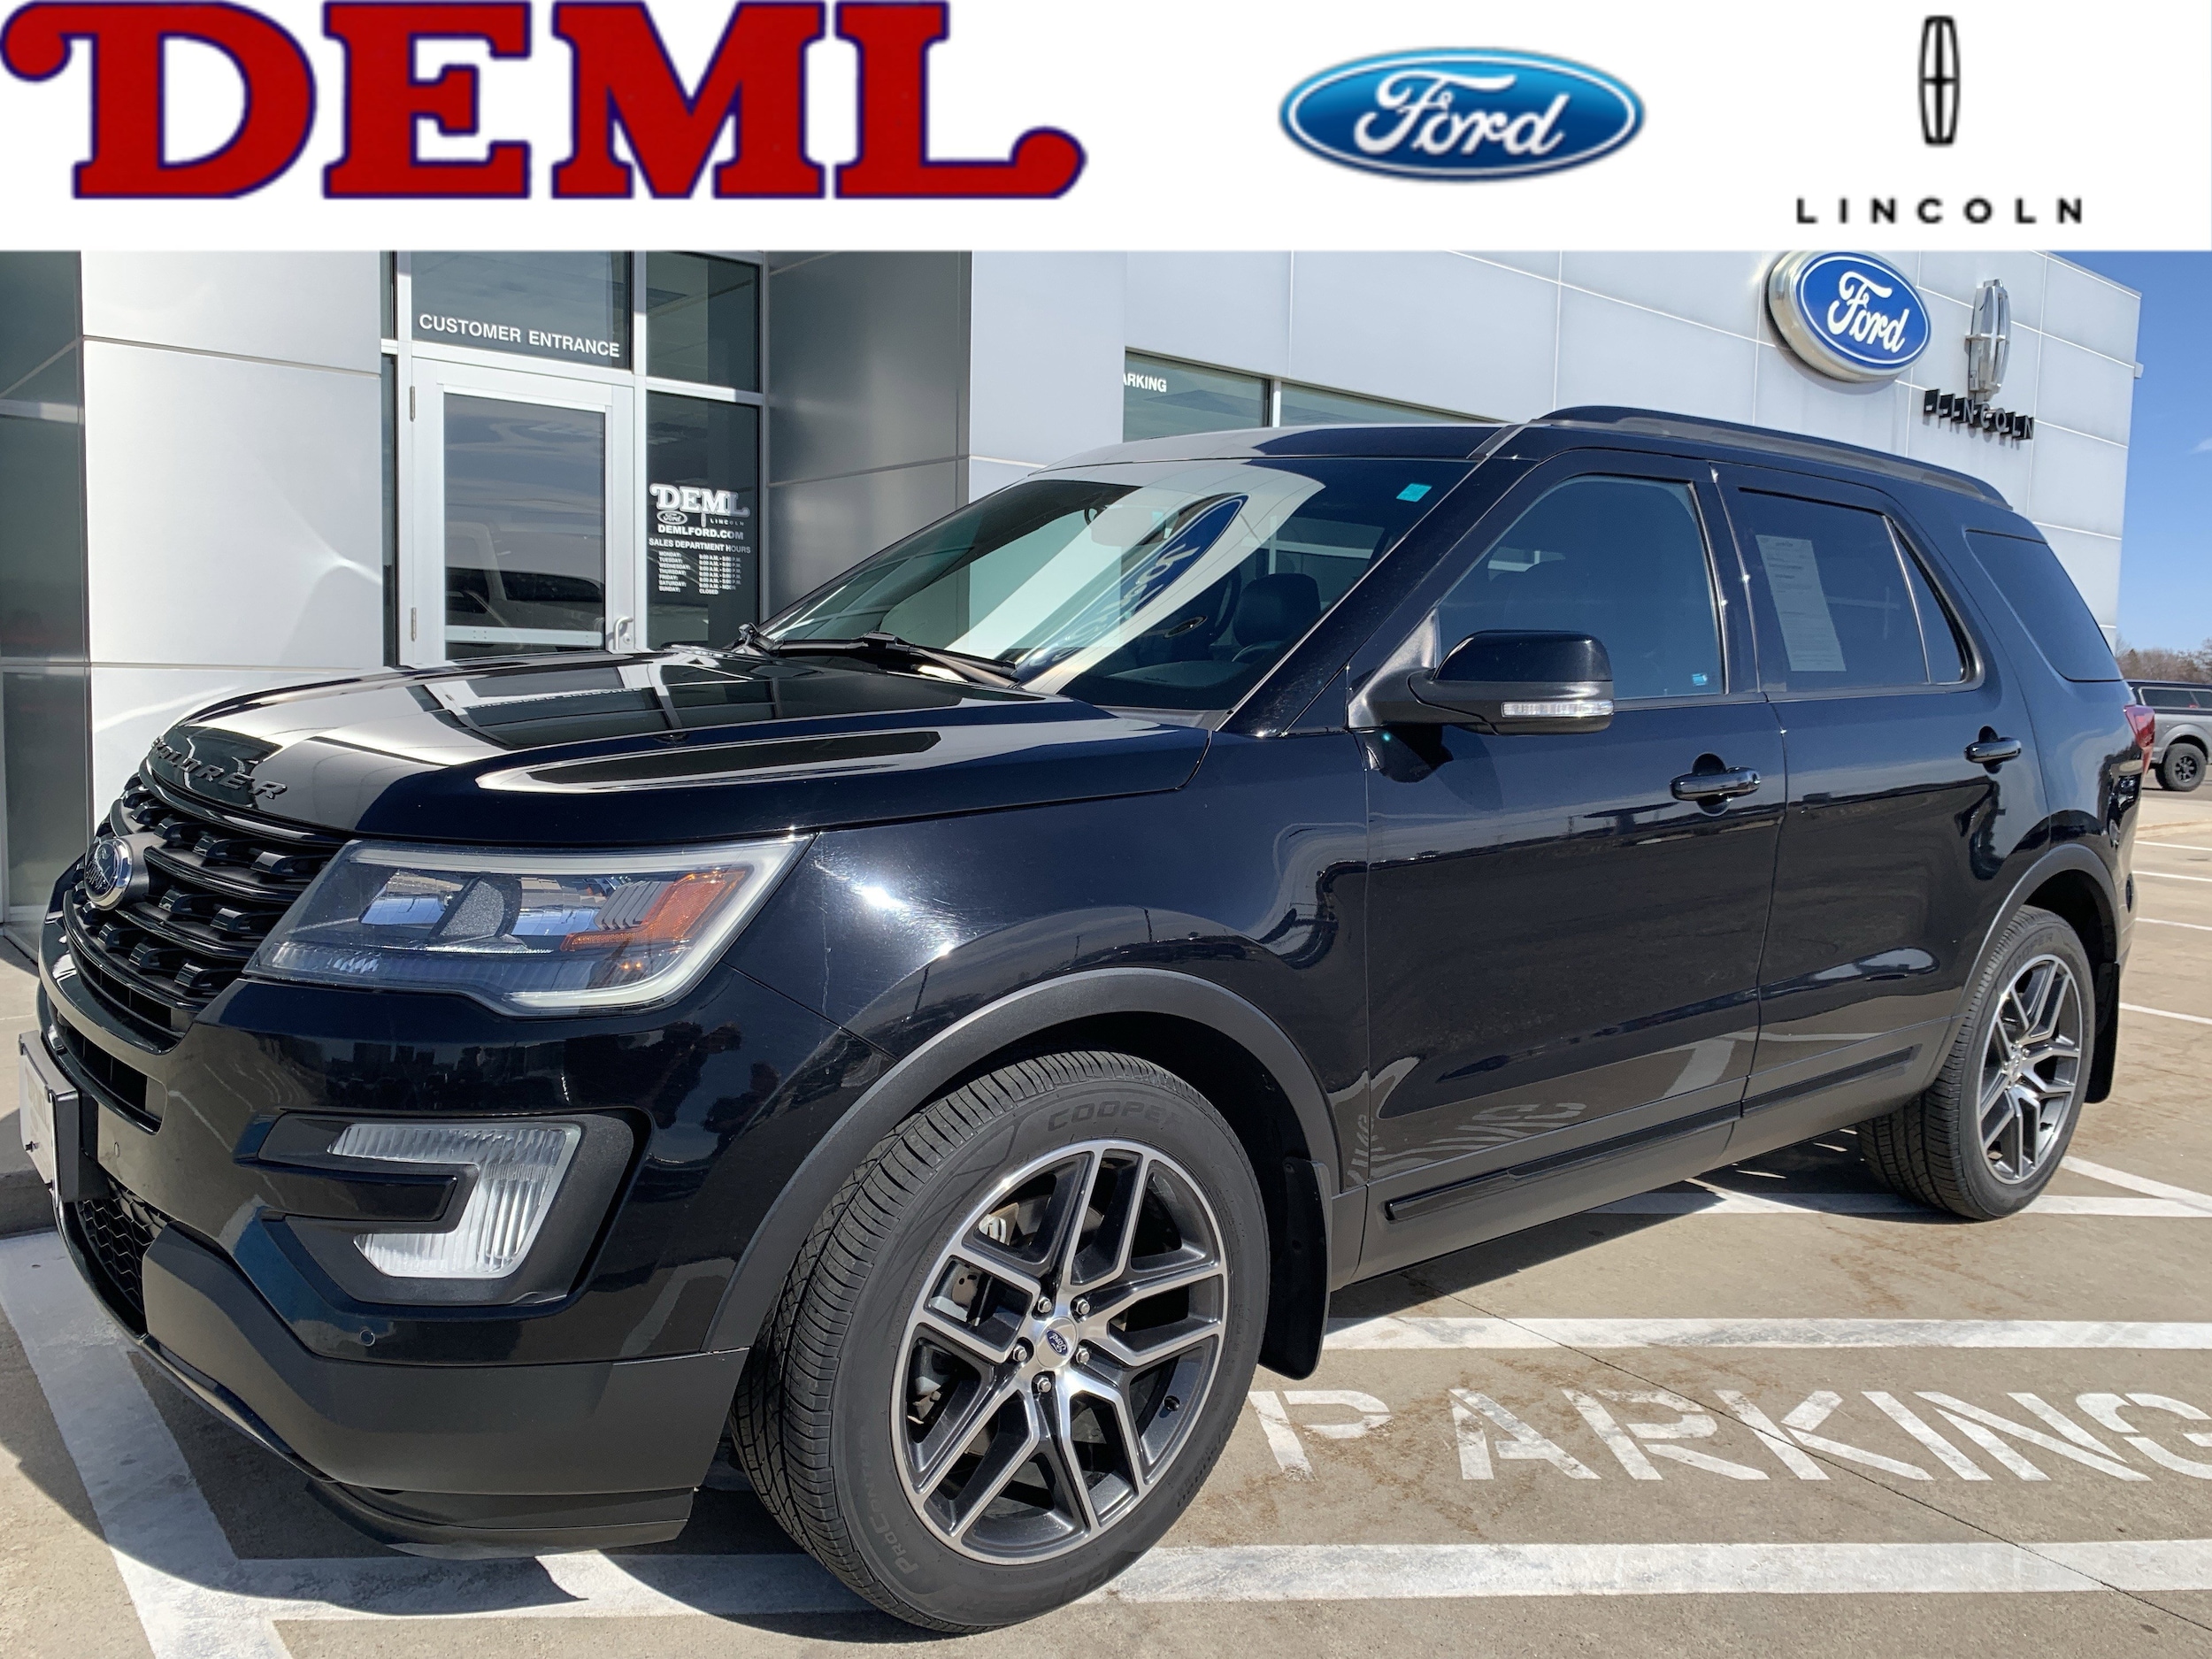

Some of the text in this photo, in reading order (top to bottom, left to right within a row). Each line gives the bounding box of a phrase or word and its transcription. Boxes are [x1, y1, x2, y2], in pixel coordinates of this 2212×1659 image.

[419, 313, 620, 358] CUSTOMER ENTRANCE
[1827, 271, 1909, 353] Ford
[1924, 388, 2035, 441] LINCOLN
[649, 483, 750, 518] DEML
[710, 518, 744, 526] LINCOLN
[649, 538, 751, 554] SALES DEPARTMENT HOURS
[657, 524, 744, 540] DEMLFORD.COM
[151, 734, 288, 799] PLORER
[1248, 1389, 2212, 1482] PARKING
[858, 1425, 920, 1575] PROCONTRO
